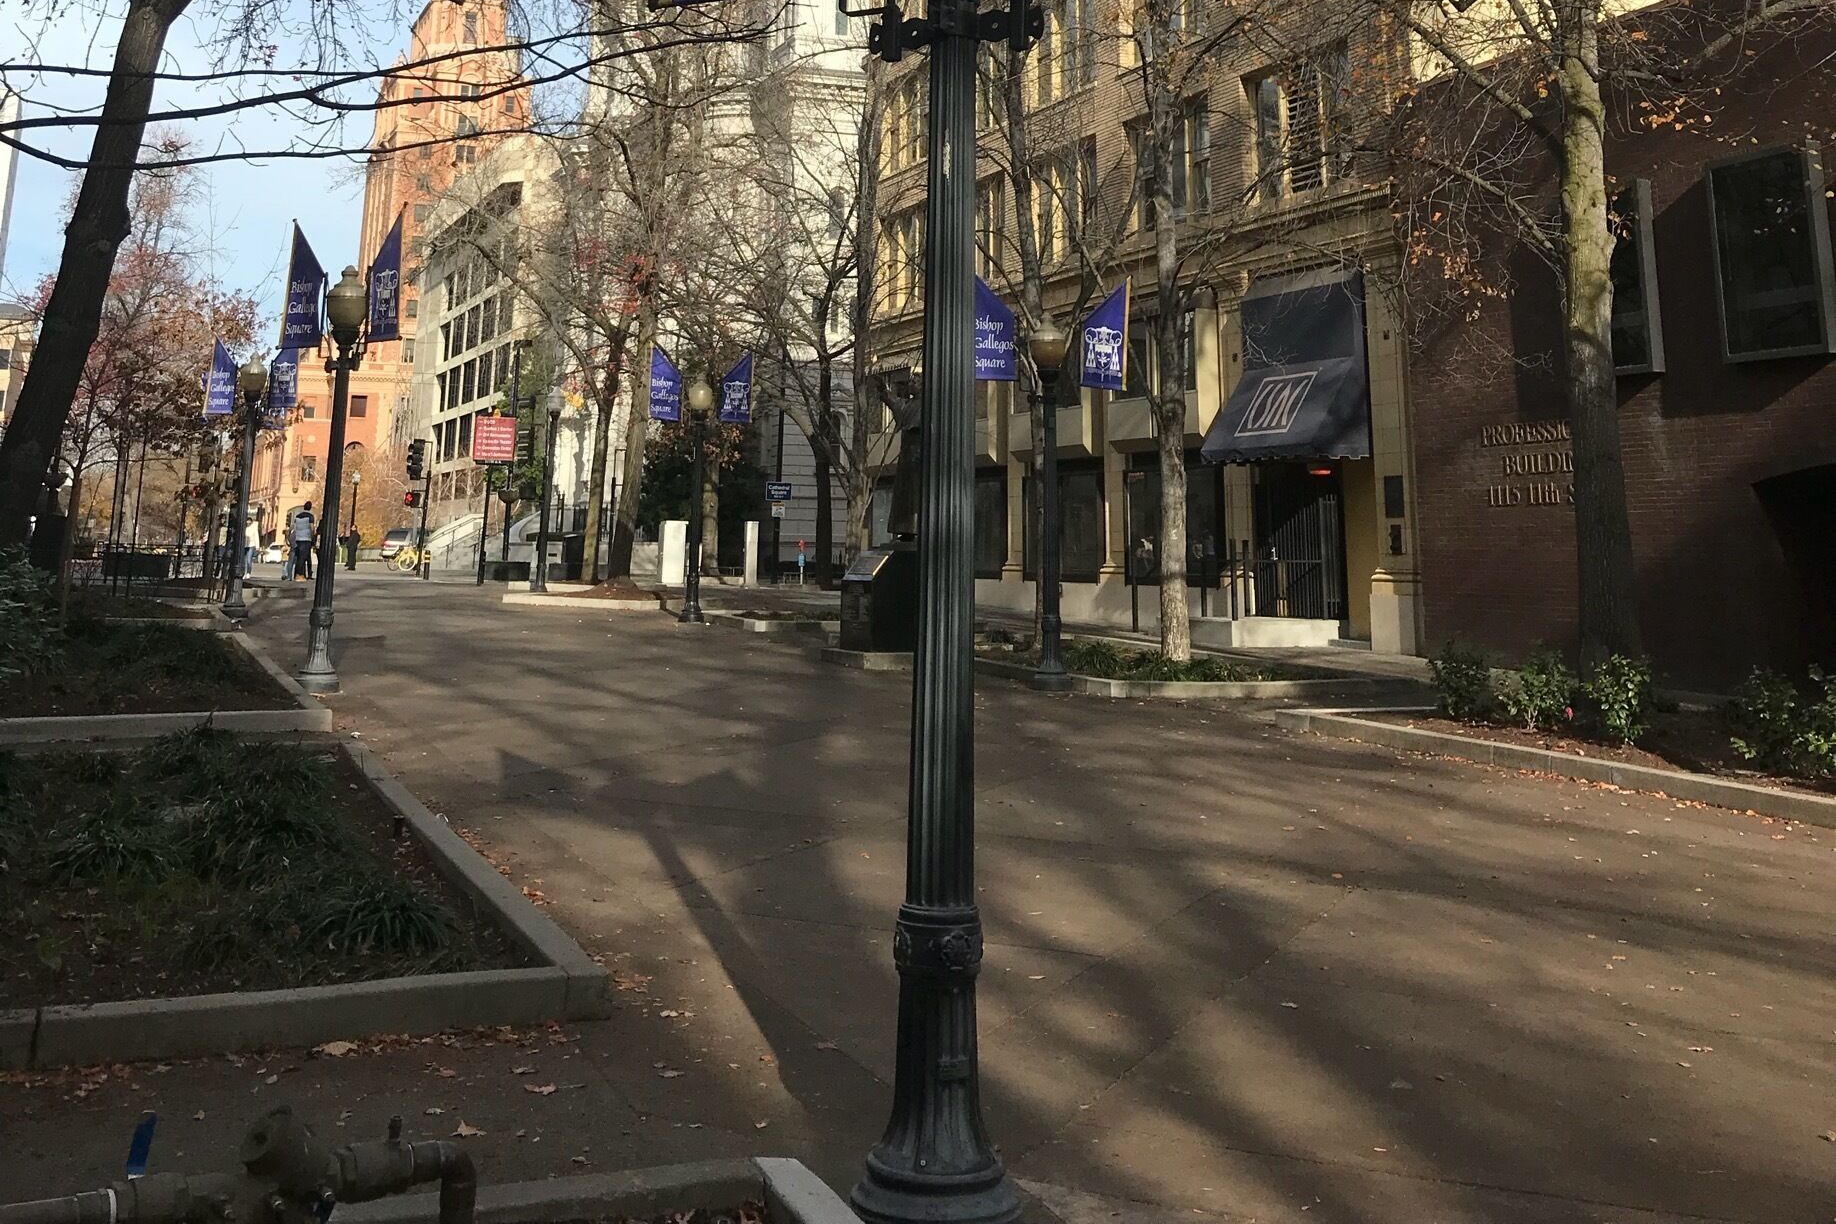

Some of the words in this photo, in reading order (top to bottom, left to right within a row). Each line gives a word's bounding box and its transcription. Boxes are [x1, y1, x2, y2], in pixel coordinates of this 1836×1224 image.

[290, 276, 313, 296] Bishop
[285, 323, 313, 339] Square
[975, 333, 1014, 353] Gallegos
[212, 367, 231, 382] Bishop
[210, 380, 235, 395] Gallegos
[651, 376, 673, 390] Bishop
[208, 397, 229, 408] Square
[650, 390, 679, 403] Gallegos
[650, 403, 672, 414] Square
[1481, 417, 1573, 448] PROFESSIO
